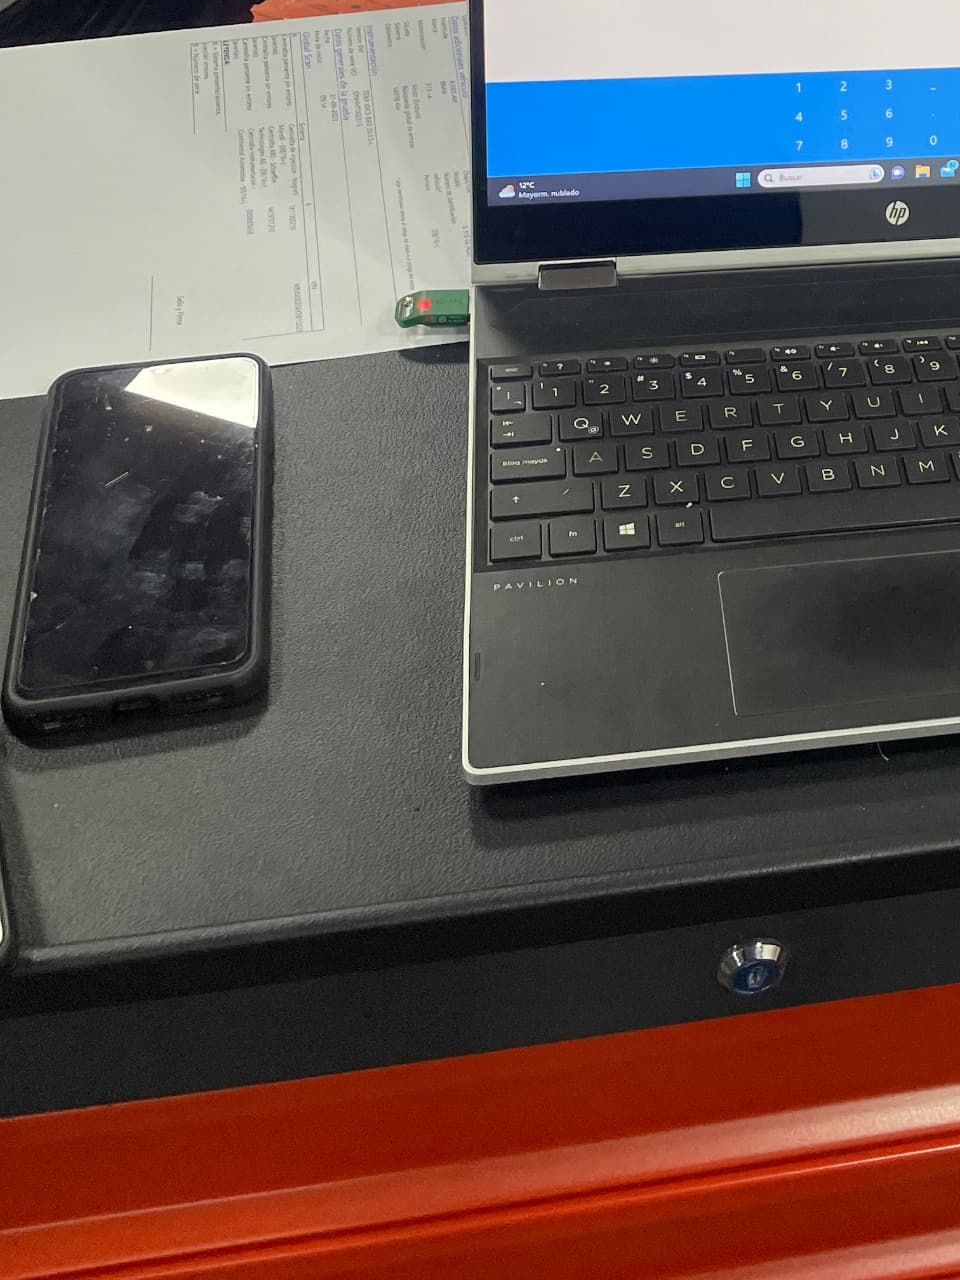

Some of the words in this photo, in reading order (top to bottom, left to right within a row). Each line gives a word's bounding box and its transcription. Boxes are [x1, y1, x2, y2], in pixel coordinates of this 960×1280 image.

[795, 82, 803, 93] 1
[839, 81, 848, 92] 2
[885, 80, 893, 91] 3
[794, 111, 803, 122] 4
[840, 110, 848, 121] 5
[885, 108, 893, 120] 6
[795, 140, 803, 152] 7
[840, 138, 849, 150] 8
[885, 136, 893, 148] 9
[929, 135, 937, 146] 0
[551, 188, 580, 197] nublado
[886, 200, 909, 225] hp
[552, 387, 559, 397] 1
[599, 384, 610, 394] 2
[649, 380, 659, 390] 3
[696, 377, 708, 387] 4
[745, 374, 755, 384] 5
[791, 370, 802, 381] 6
[838, 367, 848, 378] 7
[884, 363, 896, 375] 8
[929, 360, 940, 371] 9
[573, 416, 589, 431] Q
[621, 413, 642, 426] W
[675, 410, 687, 423] E
[724, 406, 737, 418] R
[773, 403, 785, 414] T
[820, 399, 833, 412] Y
[867, 396, 881, 408] U
[589, 451, 604, 463] A
[641, 447, 653, 459] S
[690, 443, 705, 455] D
[741, 439, 753, 451] F
[790, 436, 805, 448] G
[840, 432, 853, 445] H
[890, 428, 899, 441] J
[934, 424, 949, 437] K
[618, 484, 632, 498] Z
[670, 480, 684, 493] X
[720, 476, 734, 489] C
[771, 472, 785, 485] V
[821, 468, 835, 481] B
[870, 465, 886, 477] N
[918, 460, 935, 472] M
[493, 577, 578, 591] PAVILION
